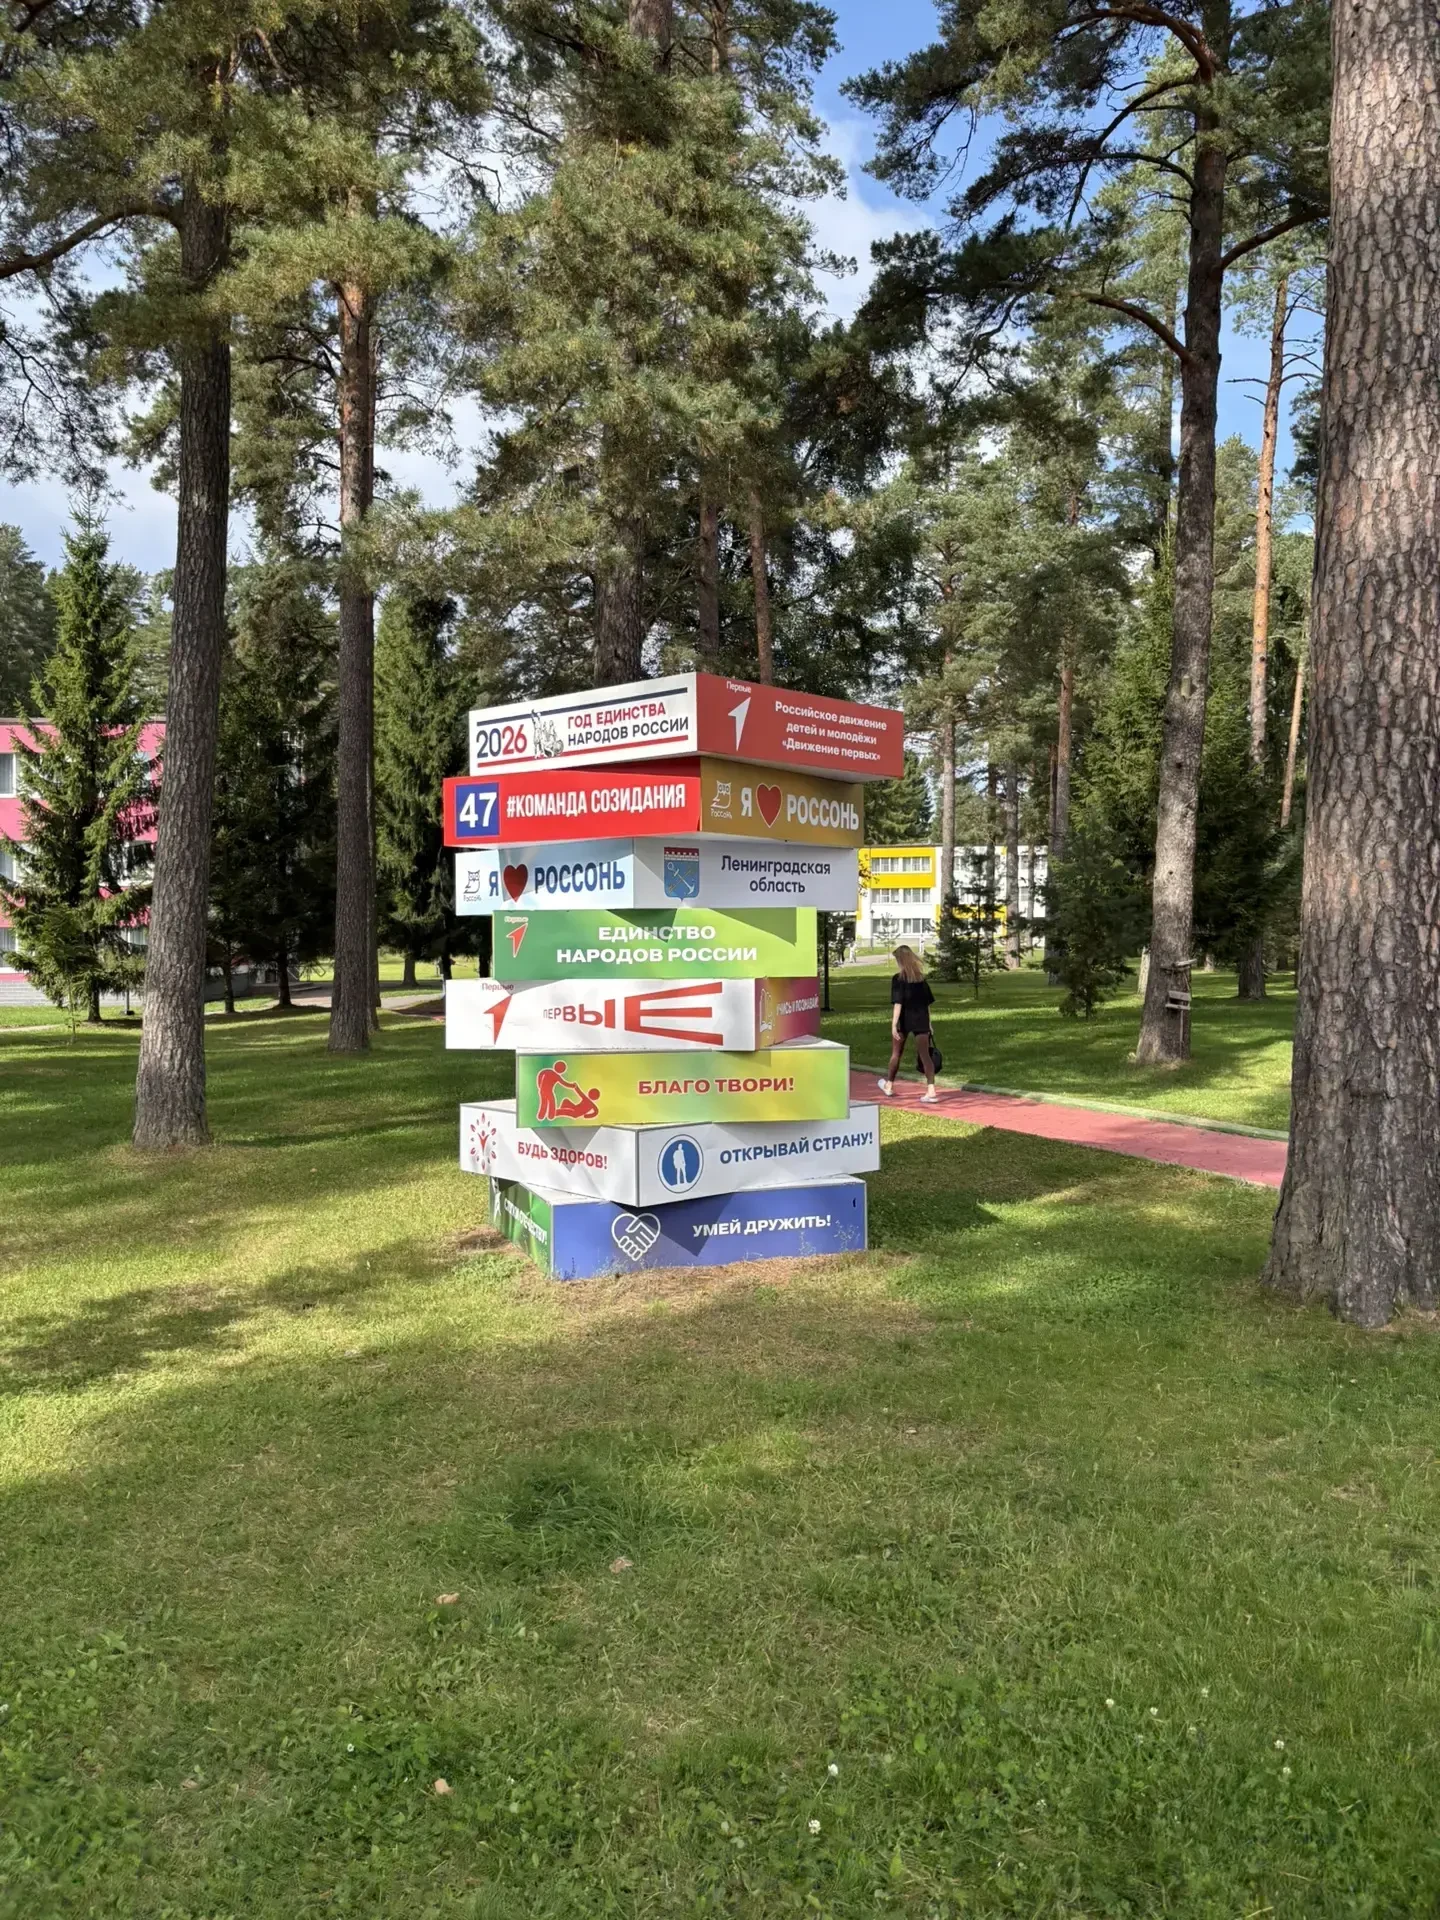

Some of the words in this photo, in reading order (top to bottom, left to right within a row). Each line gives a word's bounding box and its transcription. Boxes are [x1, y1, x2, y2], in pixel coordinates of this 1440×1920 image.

[726, 680, 752, 694] Первые
[567, 713, 592, 730] ГОД
[596, 702, 666, 725] ЕДИНСТВА
[775, 700, 838, 723] Российское
[838, 715, 887, 731] движение
[476, 724, 528, 758] 2026
[568, 723, 628, 747] НАРОДОВ
[632, 717, 689, 738] РОССИИ
[786, 722, 817, 735] детей
[819, 728, 826, 737] и
[827, 730, 877, 745] молодёжи
[782, 737, 840, 756] «Движение
[841, 747, 881, 761] первых»
[459, 791, 497, 828] 47
[506, 790, 588, 818] #КОМАНДА
[591, 783, 686, 813] СОЗИДАНИЯ
[741, 787, 752, 817] Я
[786, 794, 860, 831] РОССОНЬ
[488, 870, 499, 897] Я
[534, 861, 625, 894] РОССОНЬ
[721, 855, 831, 876] Ленинградская
[749, 877, 806, 893] область
[598, 925, 716, 943] ЕДИНСТВО
[556, 948, 663, 964] НАРОДОВ
[668, 947, 757, 962] РОССИИ
[543, 981, 724, 1046] ПЕРВЫЕ
[638, 1079, 711, 1095] БЛАГО
[714, 1077, 795, 1093] ТВОРИ!
[517, 1141, 548, 1160] БУДЬ
[550, 1147, 608, 1170] ЗДОРОВ!
[720, 1137, 810, 1164] ОТКРЫВАЙ
[812, 1131, 873, 1152] СТРАНУ!
[693, 1218, 741, 1237] УМЕЙ
[744, 1214, 831, 1236] ДРУЖИТЬ!
